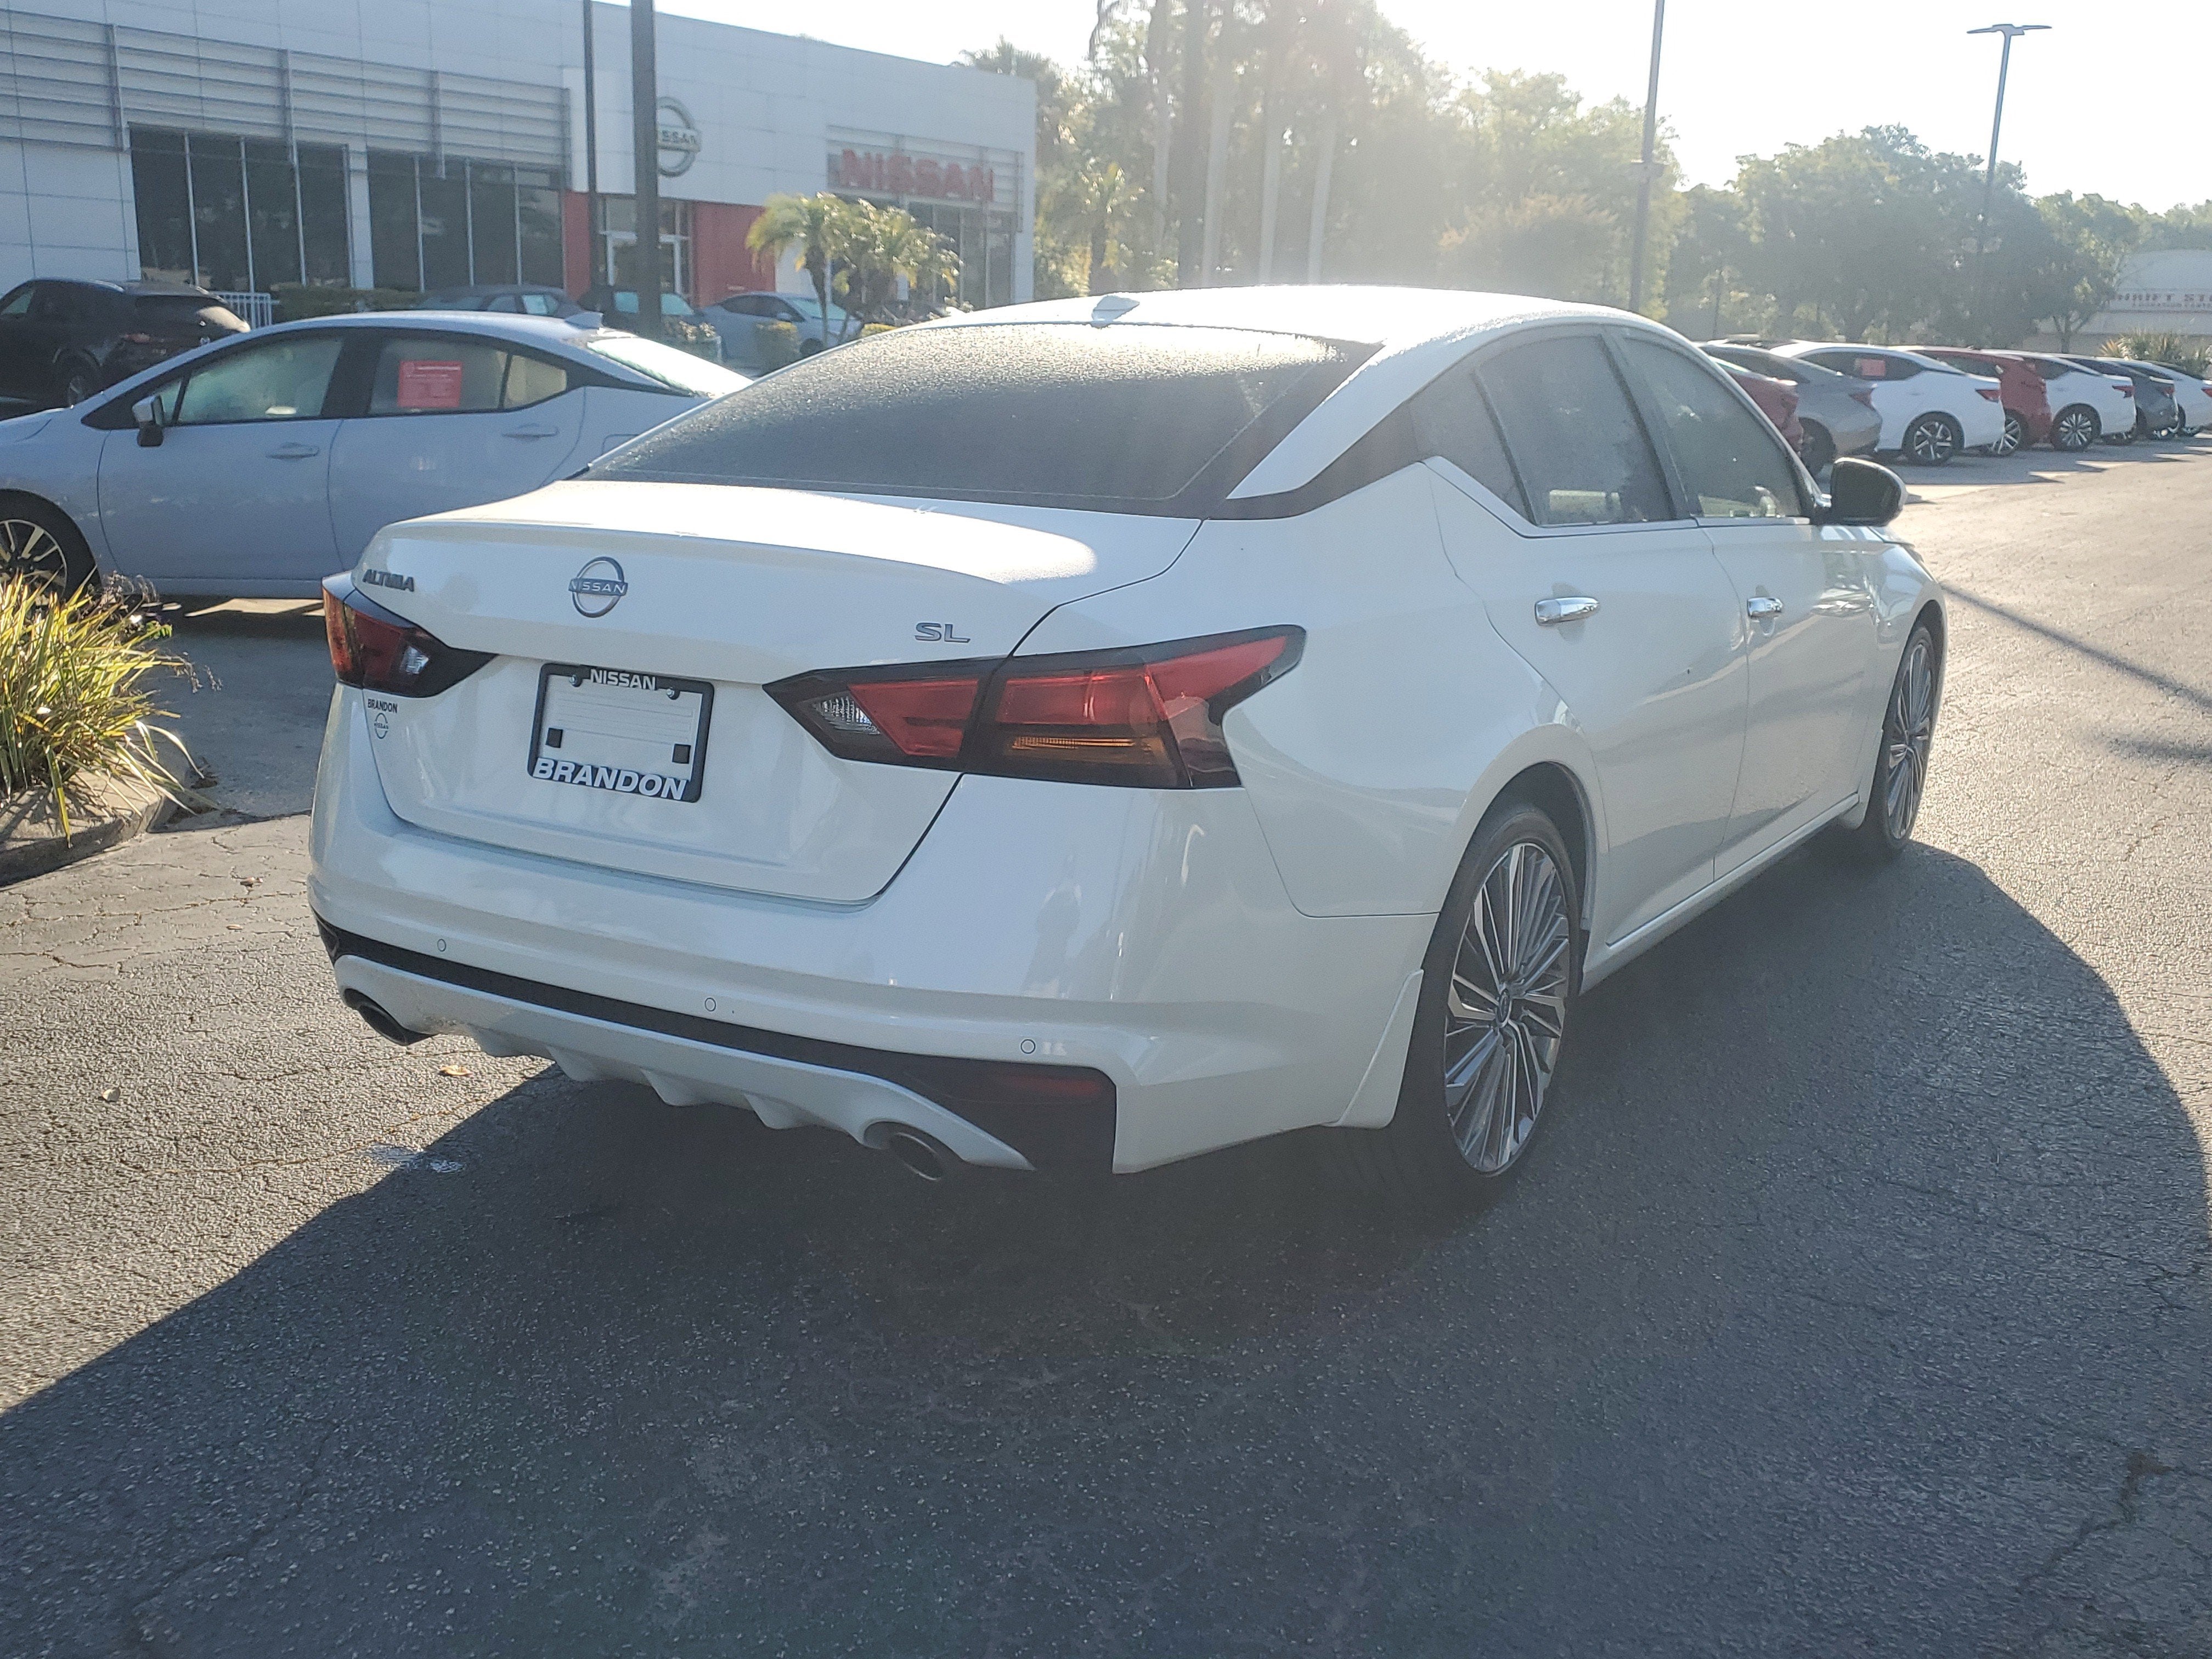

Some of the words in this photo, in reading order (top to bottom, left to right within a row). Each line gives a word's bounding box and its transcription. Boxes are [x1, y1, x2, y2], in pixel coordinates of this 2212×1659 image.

[840, 148, 994, 202] NISSAN
[362, 569, 414, 592] ALTIMA
[571, 580, 625, 594] NISSAN
[915, 623, 970, 643] SL
[590, 669, 657, 691] NISSAN
[368, 698, 398, 714] BRANDON
[533, 758, 687, 800] BRANDON
